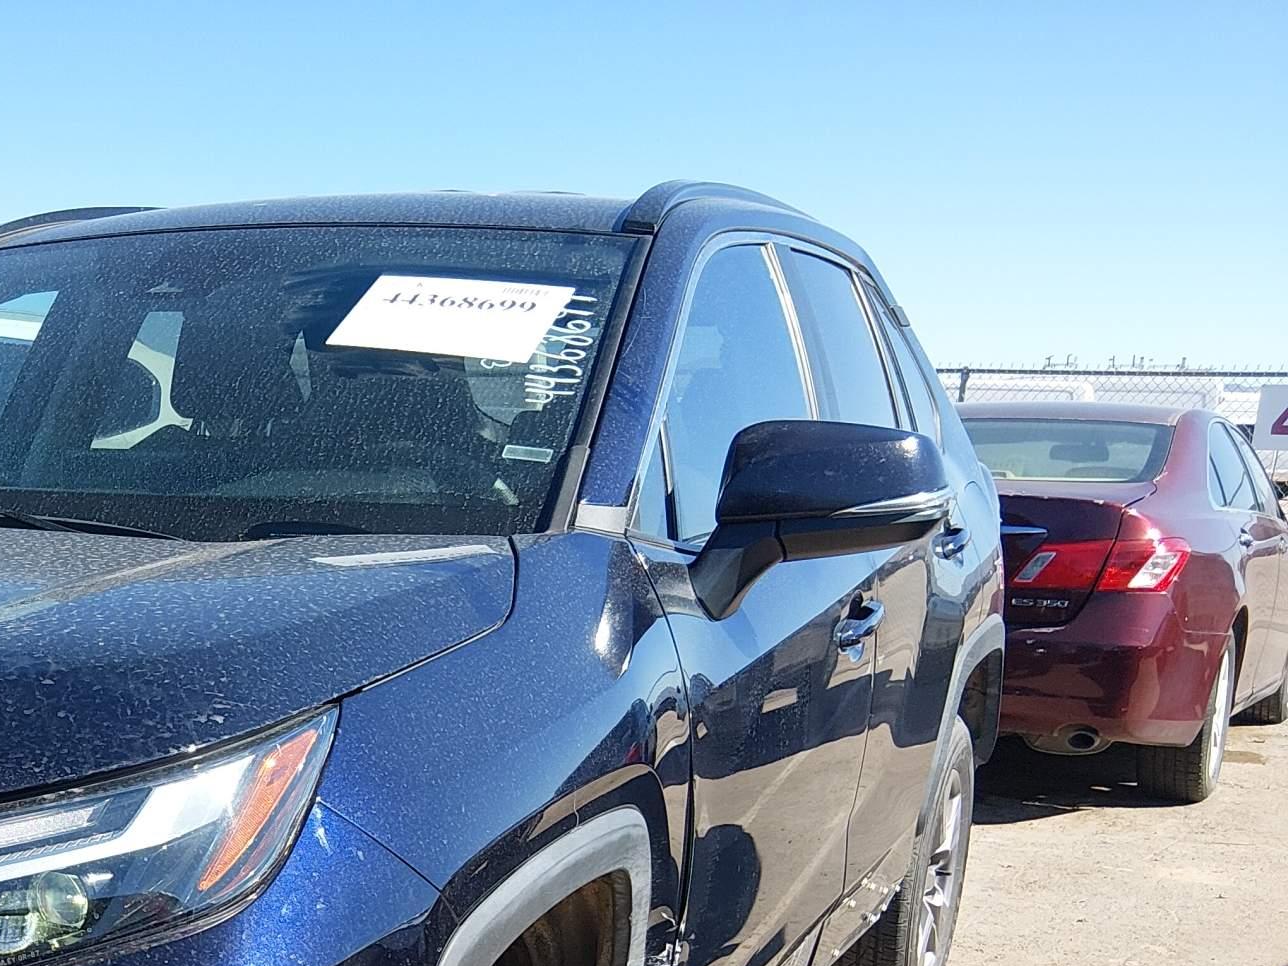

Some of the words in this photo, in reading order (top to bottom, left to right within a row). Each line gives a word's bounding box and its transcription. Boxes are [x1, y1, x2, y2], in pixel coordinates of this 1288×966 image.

[383, 292, 537, 313] 44368699
[1012, 598, 1034, 606] ES
[1036, 599, 1069, 608] 350
